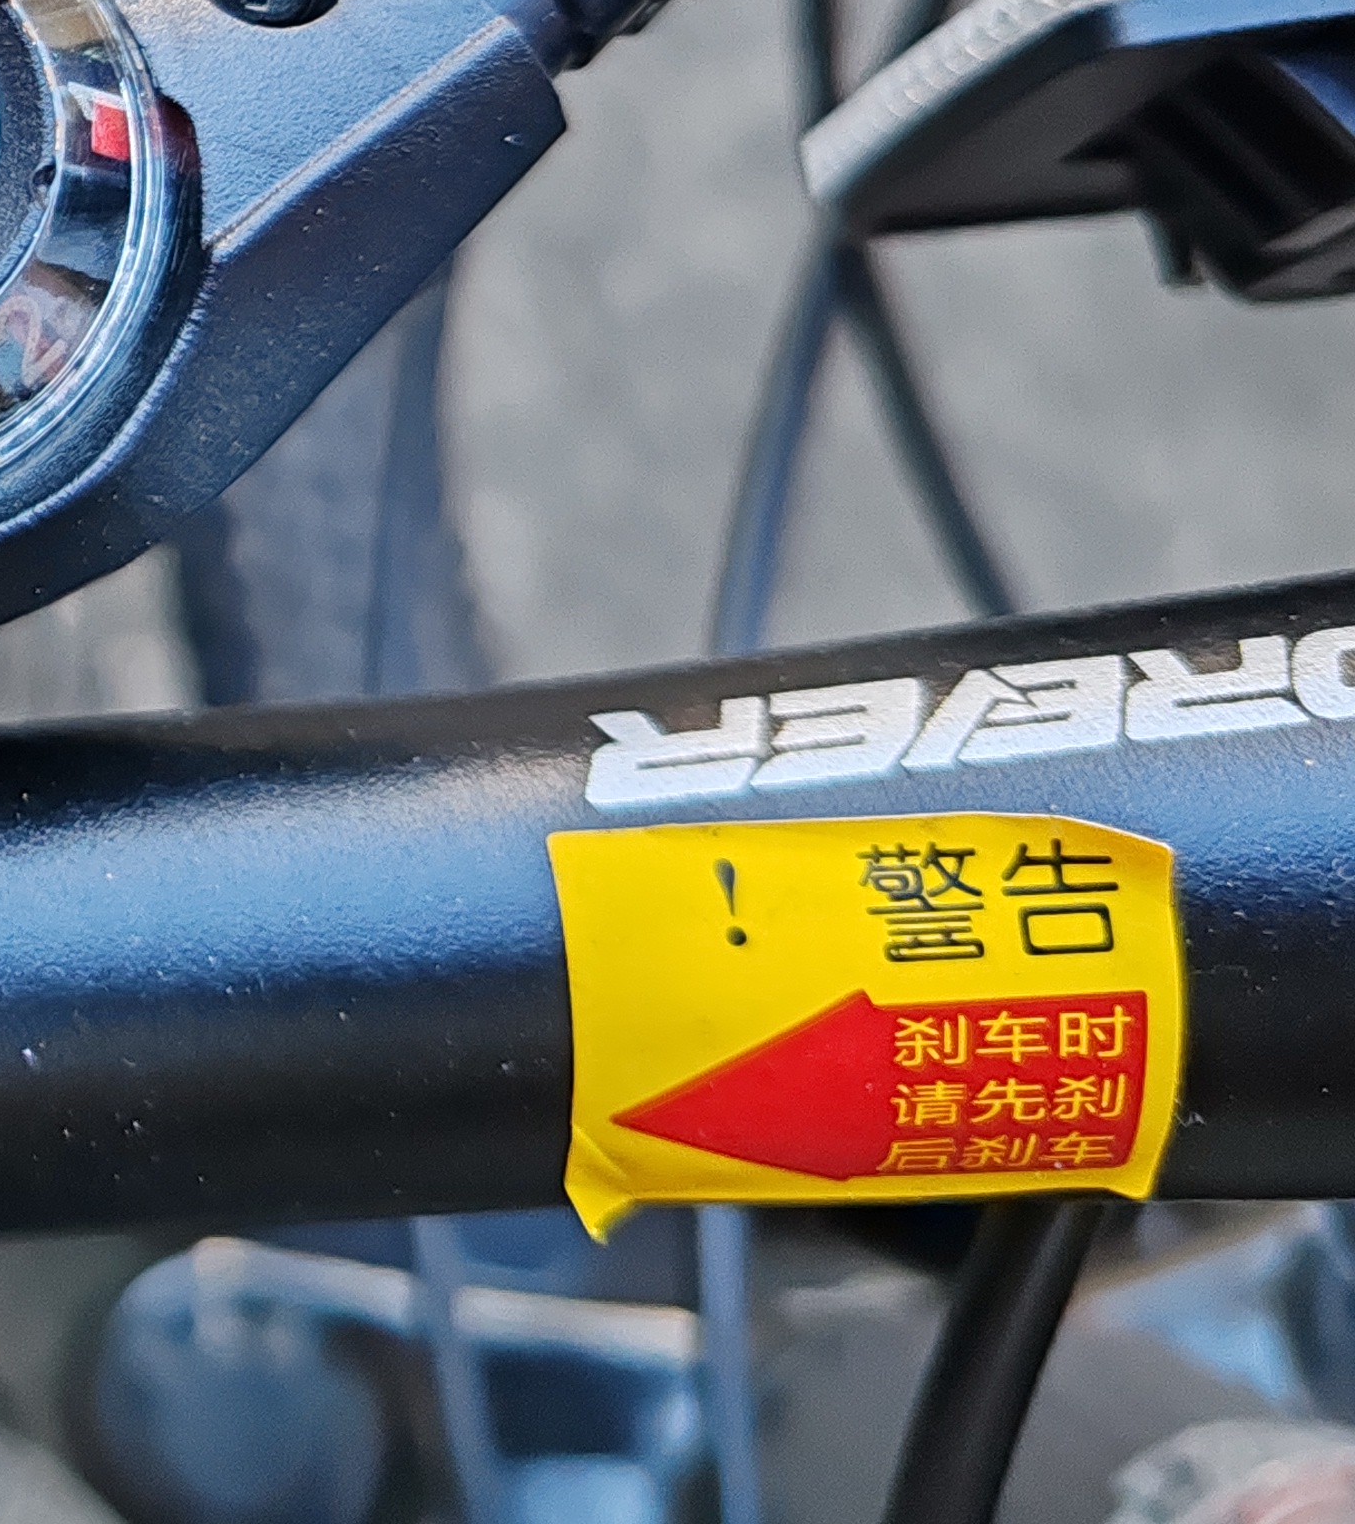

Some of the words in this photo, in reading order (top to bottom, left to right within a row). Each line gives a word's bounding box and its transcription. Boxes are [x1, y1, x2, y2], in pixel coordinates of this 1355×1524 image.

[856, 837, 1119, 963] 警告
[894, 1005, 1133, 1067] 刹车时
[890, 1073, 1128, 1126] 请先刹
[876, 1131, 1116, 1172] 后刹车
